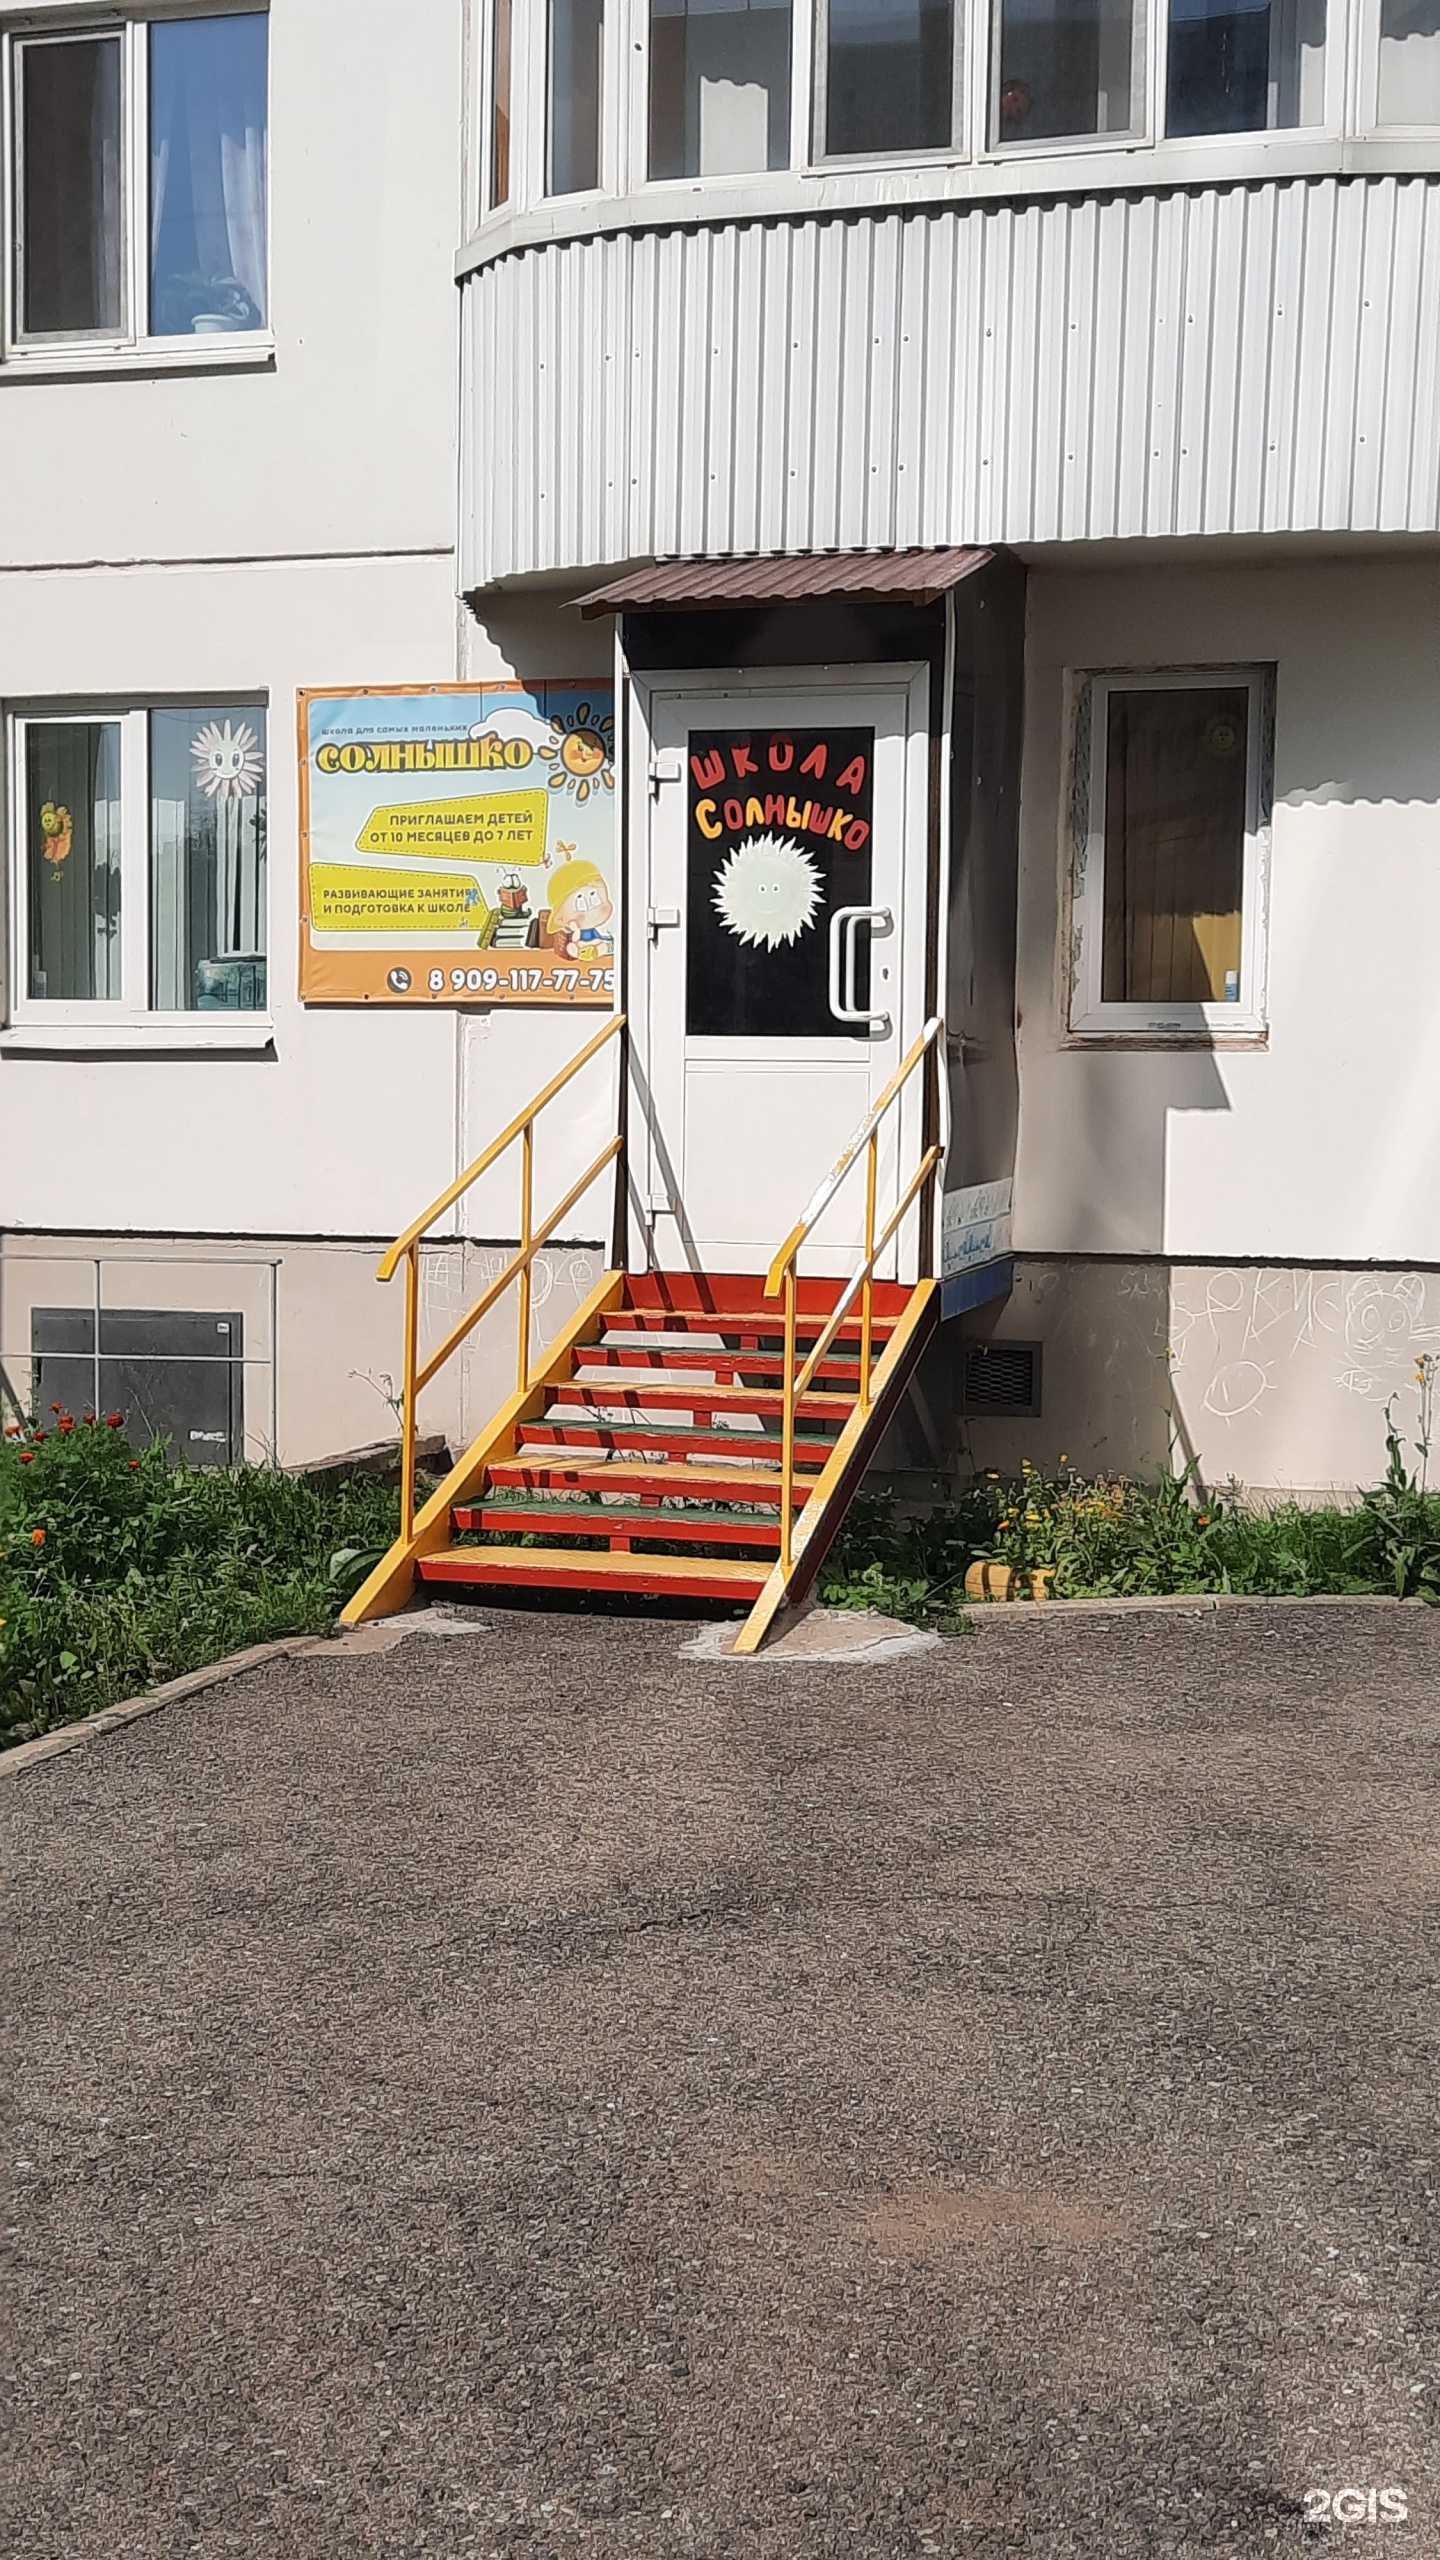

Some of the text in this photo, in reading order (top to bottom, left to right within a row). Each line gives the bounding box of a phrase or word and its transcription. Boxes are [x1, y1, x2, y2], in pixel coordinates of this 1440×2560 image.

[316, 731, 533, 773] СОЛНЫШКО
[691, 736, 866, 794] ШКОЛА
[390, 810, 533, 826] ПРИГЛАШАЕМ ДЕТЕЙ
[370, 830, 533, 844] ОТ 10 МЕСЯЦЕВ ДО 7 ЛЕТ
[323, 889, 415, 900] РАЗВИВАЮЩИЕ
[323, 903, 471, 916] И ПОДГОТОВКА К ШКОЛЕ
[429, 968, 615, 992] 8 909-117-77-75
